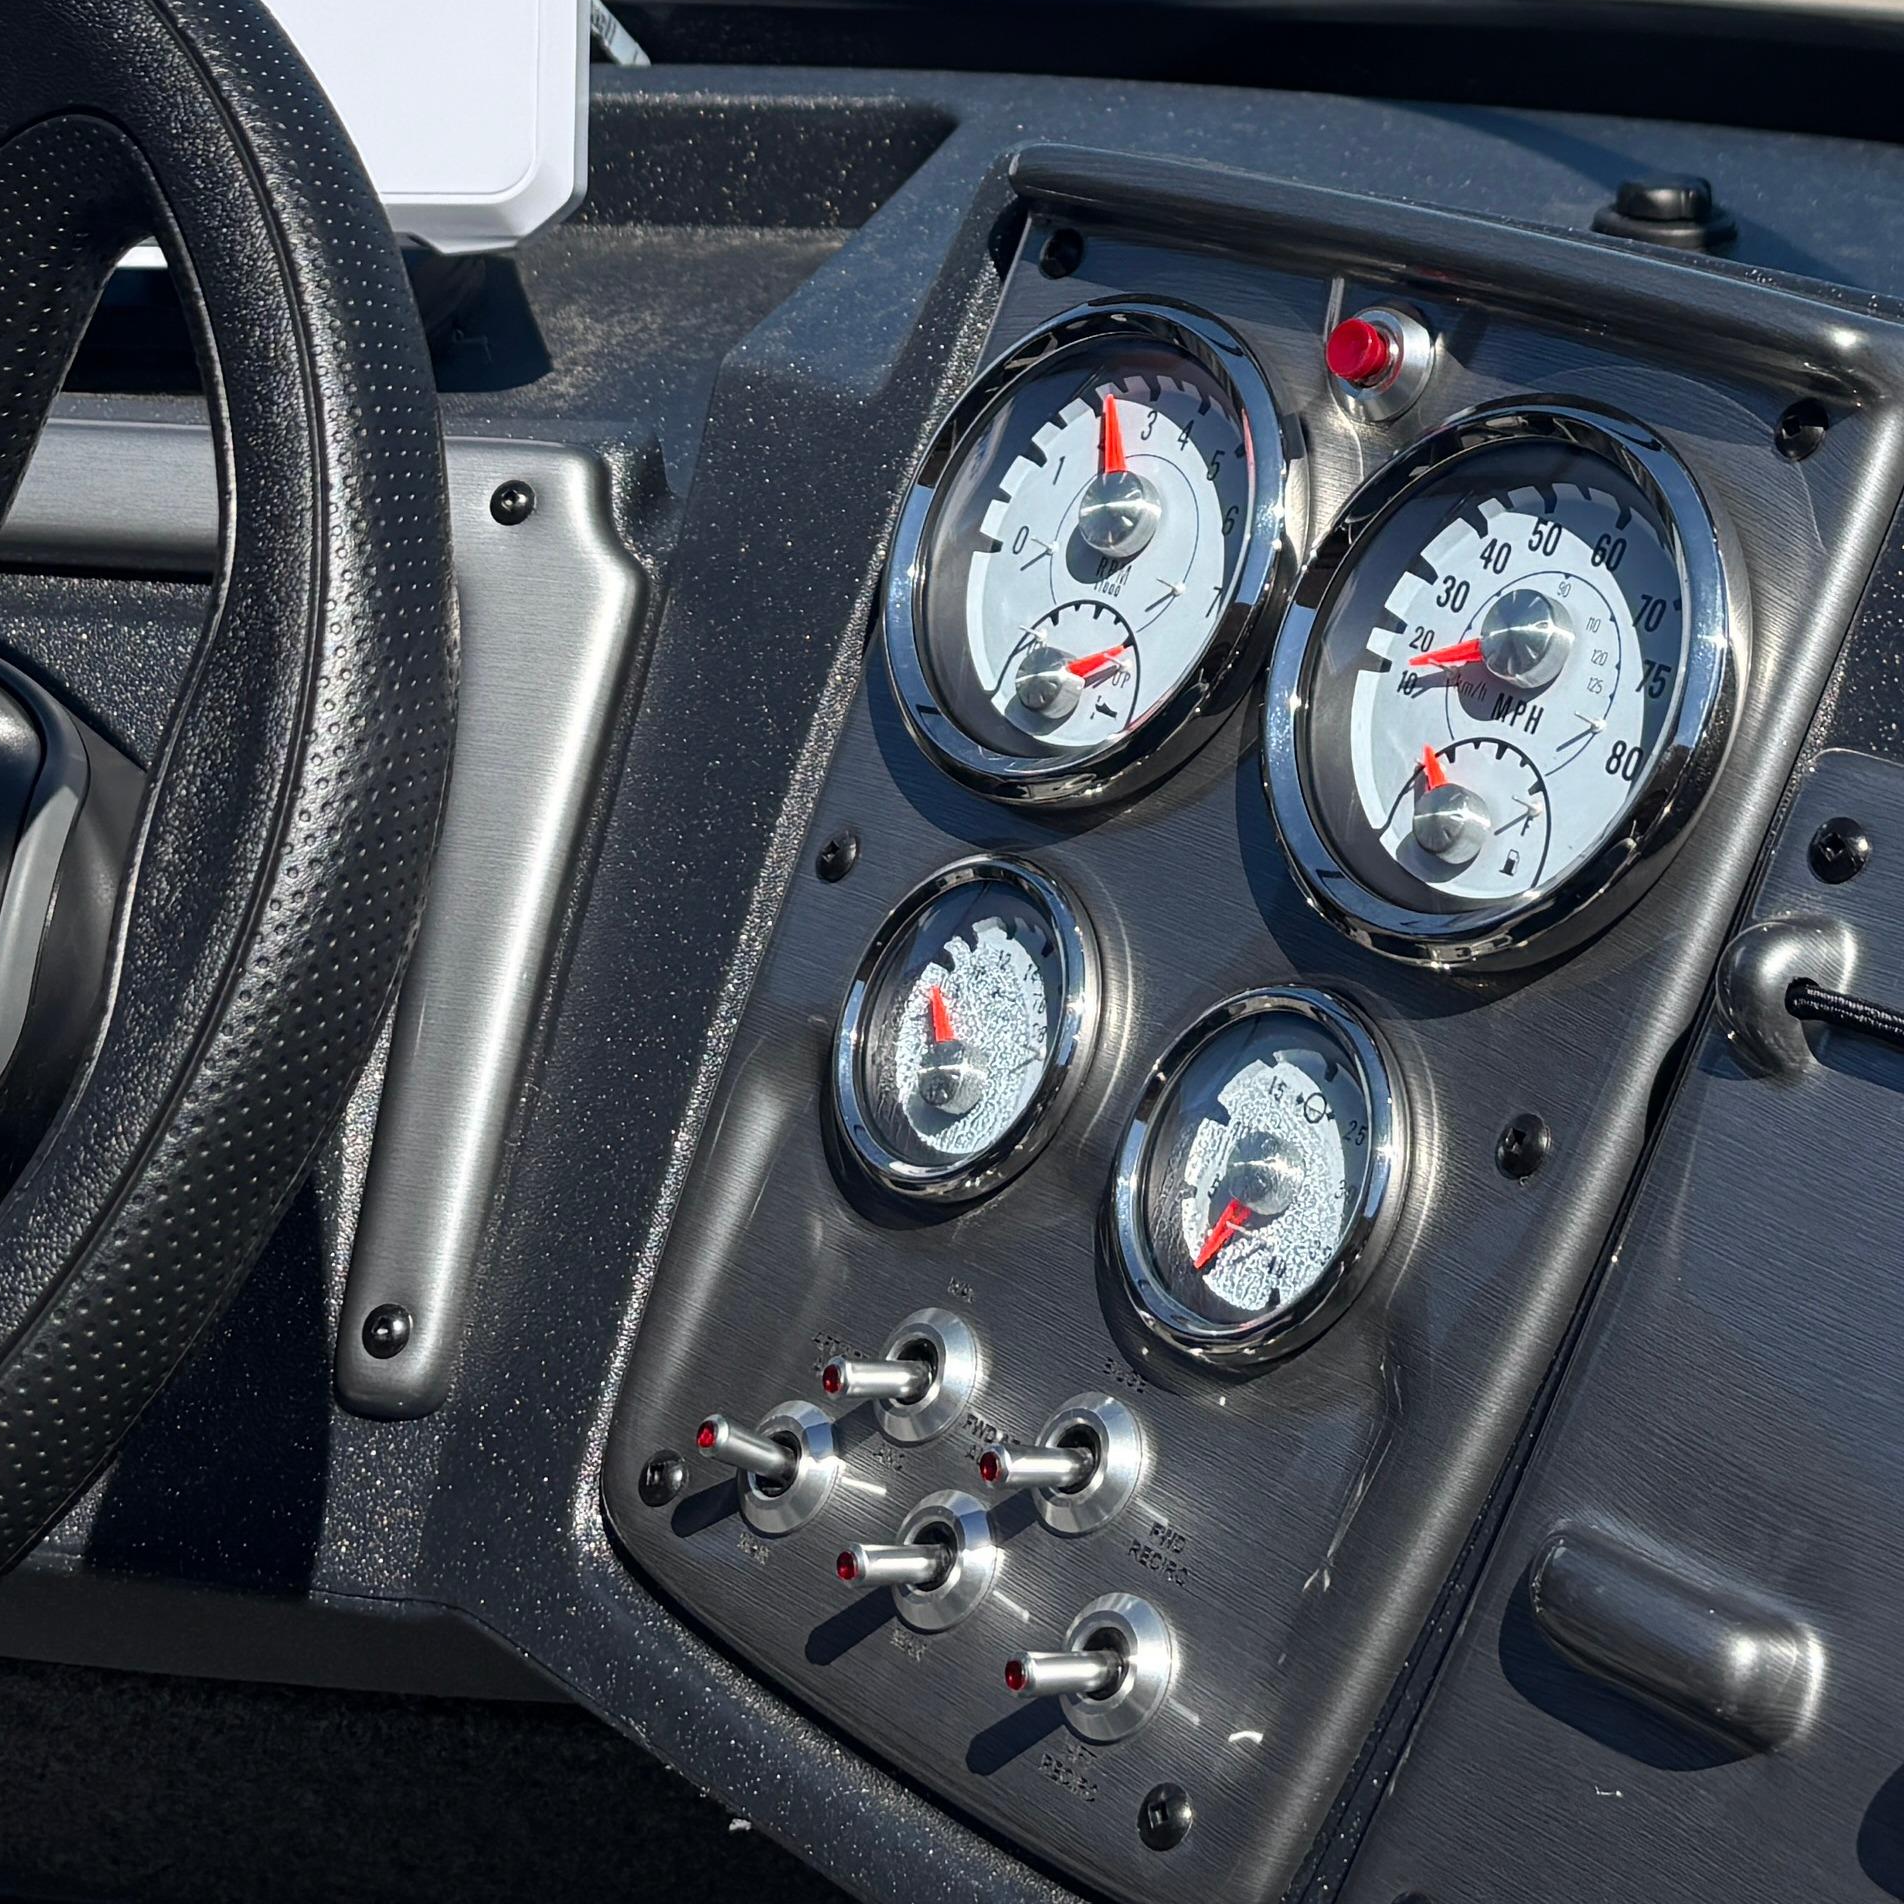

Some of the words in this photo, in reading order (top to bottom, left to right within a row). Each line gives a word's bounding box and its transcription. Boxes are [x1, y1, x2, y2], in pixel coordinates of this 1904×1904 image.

[1140, 410, 1158, 440] 3
[1178, 420, 1194, 451] 4
[1052, 456, 1065, 485] 1
[1207, 450, 1225, 481] 5
[1222, 505, 1239, 535] 6
[1013, 526, 1029, 555] 0
[1528, 517, 1562, 557] 50
[1591, 533, 1627, 572] 60
[1480, 538, 1512, 574] 40
[1436, 575, 1470, 613] 30
[1633, 594, 1666, 632] 70
[1409, 626, 1435, 652] 20
[1397, 670, 1418, 696] 10
[1636, 659, 1671, 699] 75
[1491, 692, 1544, 734] MPH
[1605, 740, 1644, 782] 80
[1269, 1076, 1287, 1100] 15
[1346, 1120, 1368, 1146] 25
